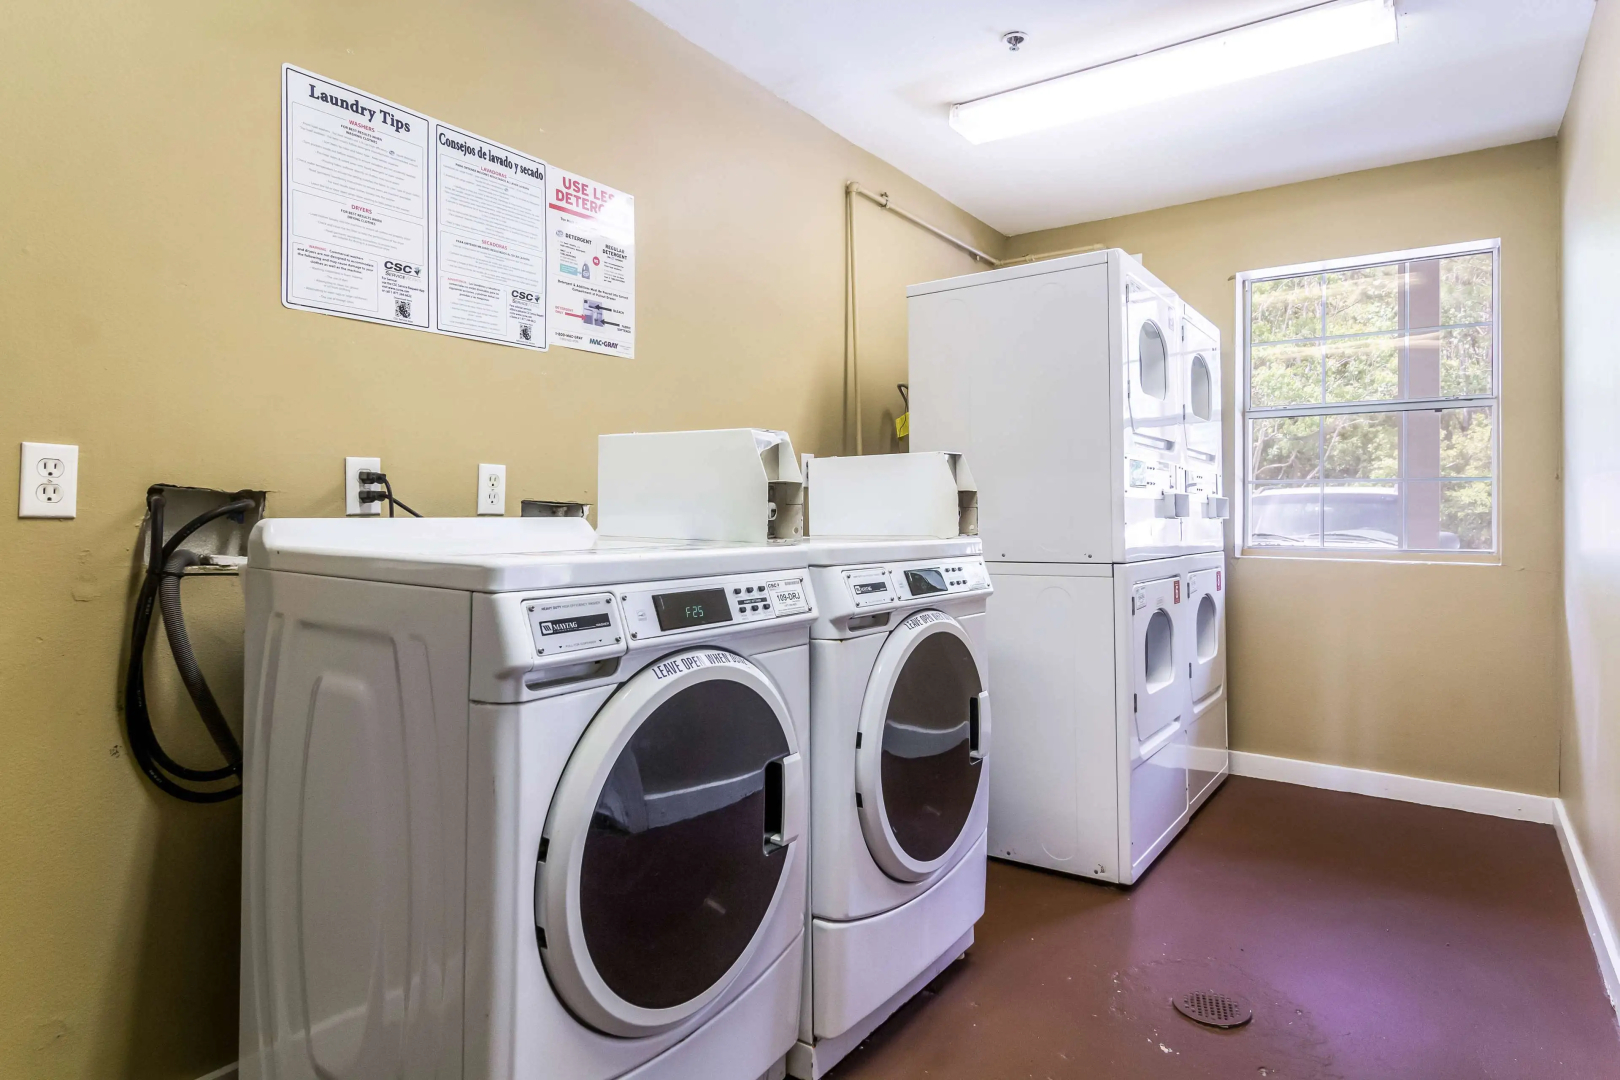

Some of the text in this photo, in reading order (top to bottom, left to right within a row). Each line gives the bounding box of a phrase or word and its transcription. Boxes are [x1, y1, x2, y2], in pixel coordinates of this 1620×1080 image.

[309, 84, 410, 133] Laundry Tips
[348, 120, 375, 132] WASHERS
[439, 133, 543, 180] Consejos de lavado y secado
[563, 177, 589, 196] USE
[351, 204, 372, 214] DRYERS
[565, 233, 592, 245] DETERGENT
[602, 249, 627, 259] DETERGENT
[605, 244, 625, 254] REGULAR
[384, 261, 412, 274] CSC
[511, 290, 533, 301] CSC
[553, 622, 577, 630] MAYTAG
[904, 617, 923, 630] LEAVE
[652, 660, 683, 679] LEAVE
[681, 656, 705, 670] OPEN
[705, 653, 730, 664] WHEN
